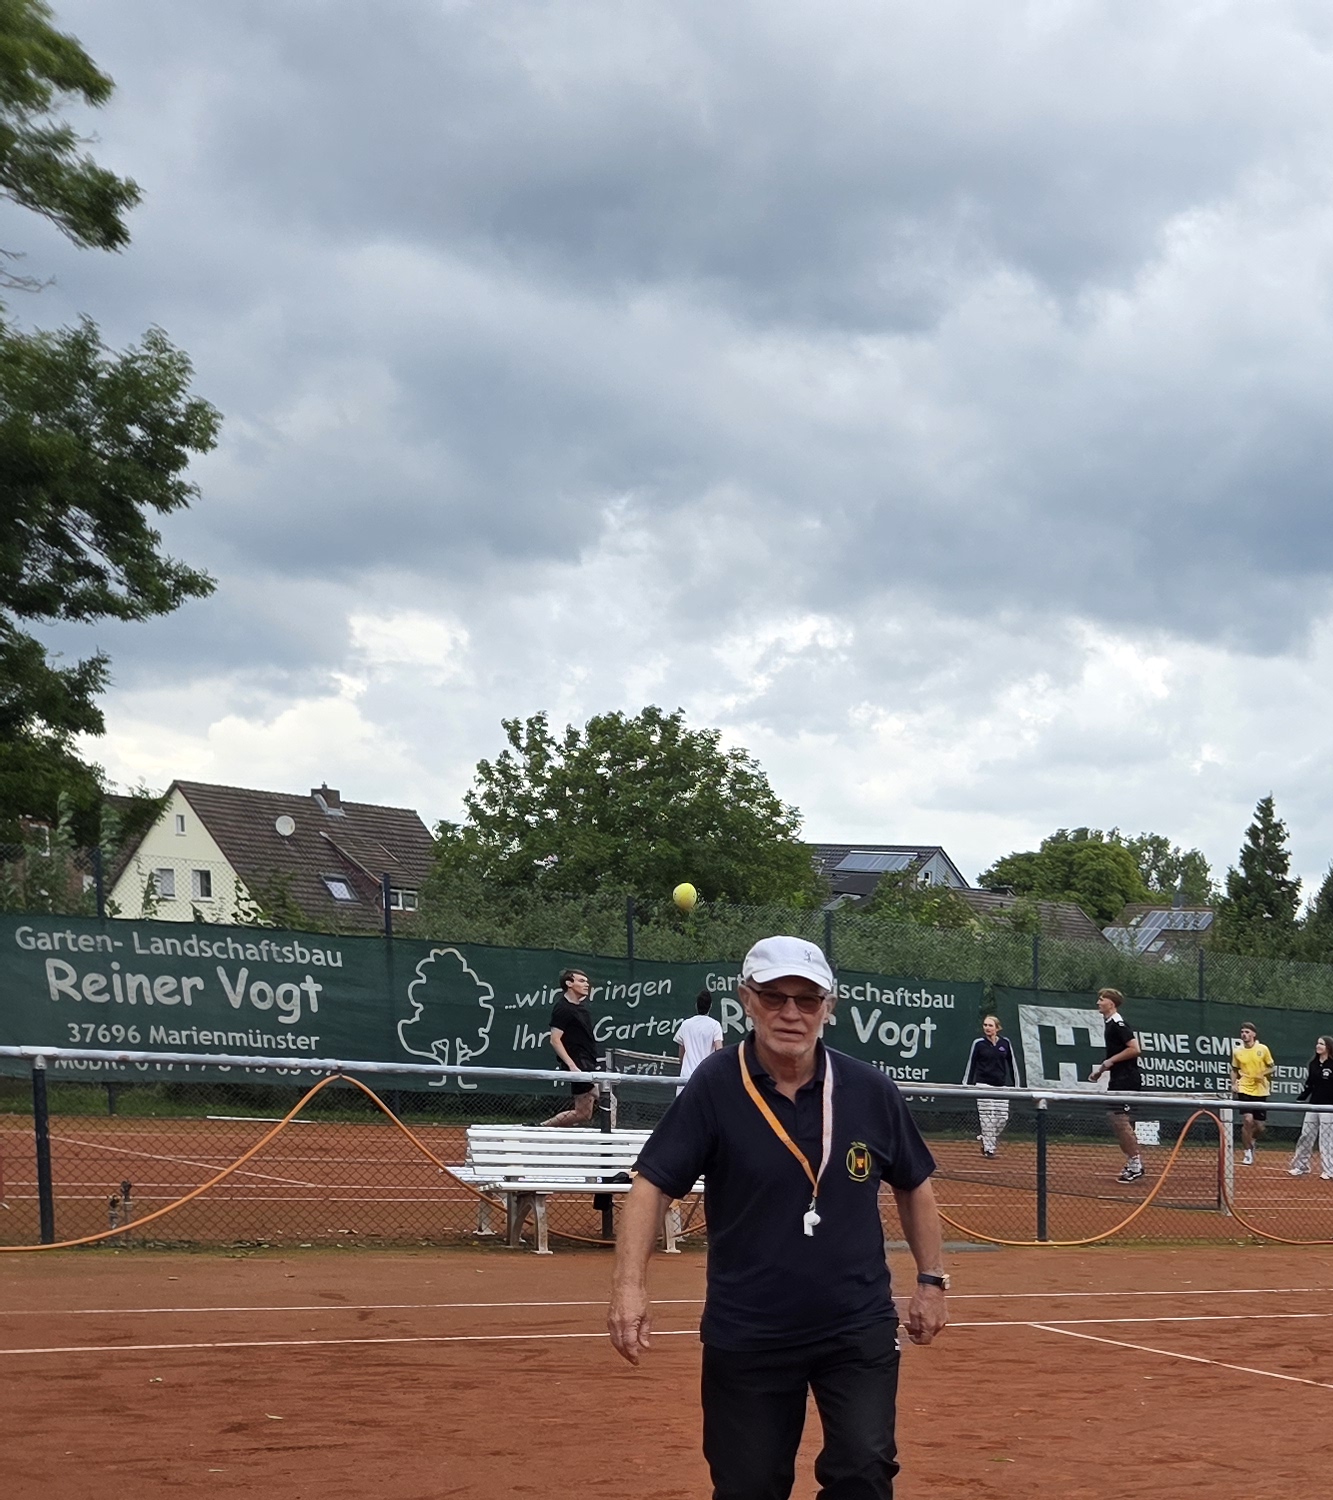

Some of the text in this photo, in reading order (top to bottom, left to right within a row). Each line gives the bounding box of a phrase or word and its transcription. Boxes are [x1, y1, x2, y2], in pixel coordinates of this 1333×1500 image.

[15, 926, 343, 967] Garten- Landschaftsbau
[45, 957, 323, 1024] Reiner Vogt
[589, 978, 672, 1008] ringen
[833, 978, 955, 1009] schaftsbau
[67, 1023, 320, 1050] 37696 Marienmünster
[512, 1023, 552, 1051] Ihr
[850, 1006, 937, 1059] Vogt
[1203, 1077, 1214, 1090] &
